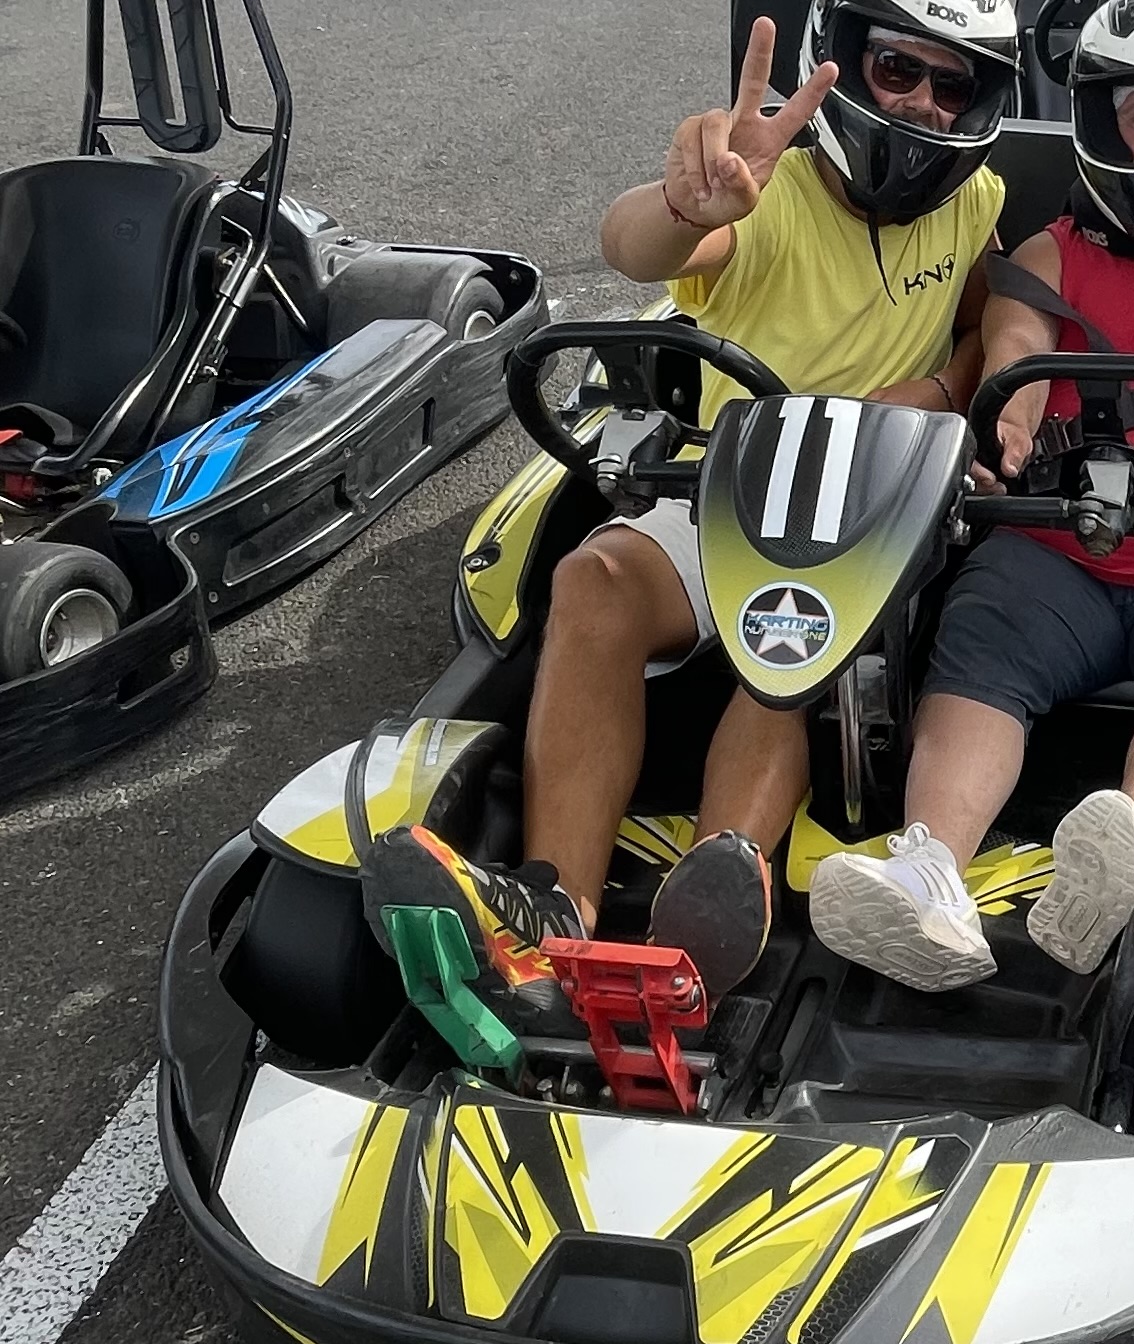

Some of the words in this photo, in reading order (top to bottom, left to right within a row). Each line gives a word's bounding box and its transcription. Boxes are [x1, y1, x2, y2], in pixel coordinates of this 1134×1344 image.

[926, 1, 969, 28] BOXS
[760, 396, 863, 544] 11
[745, 613, 829, 632] KARTING
